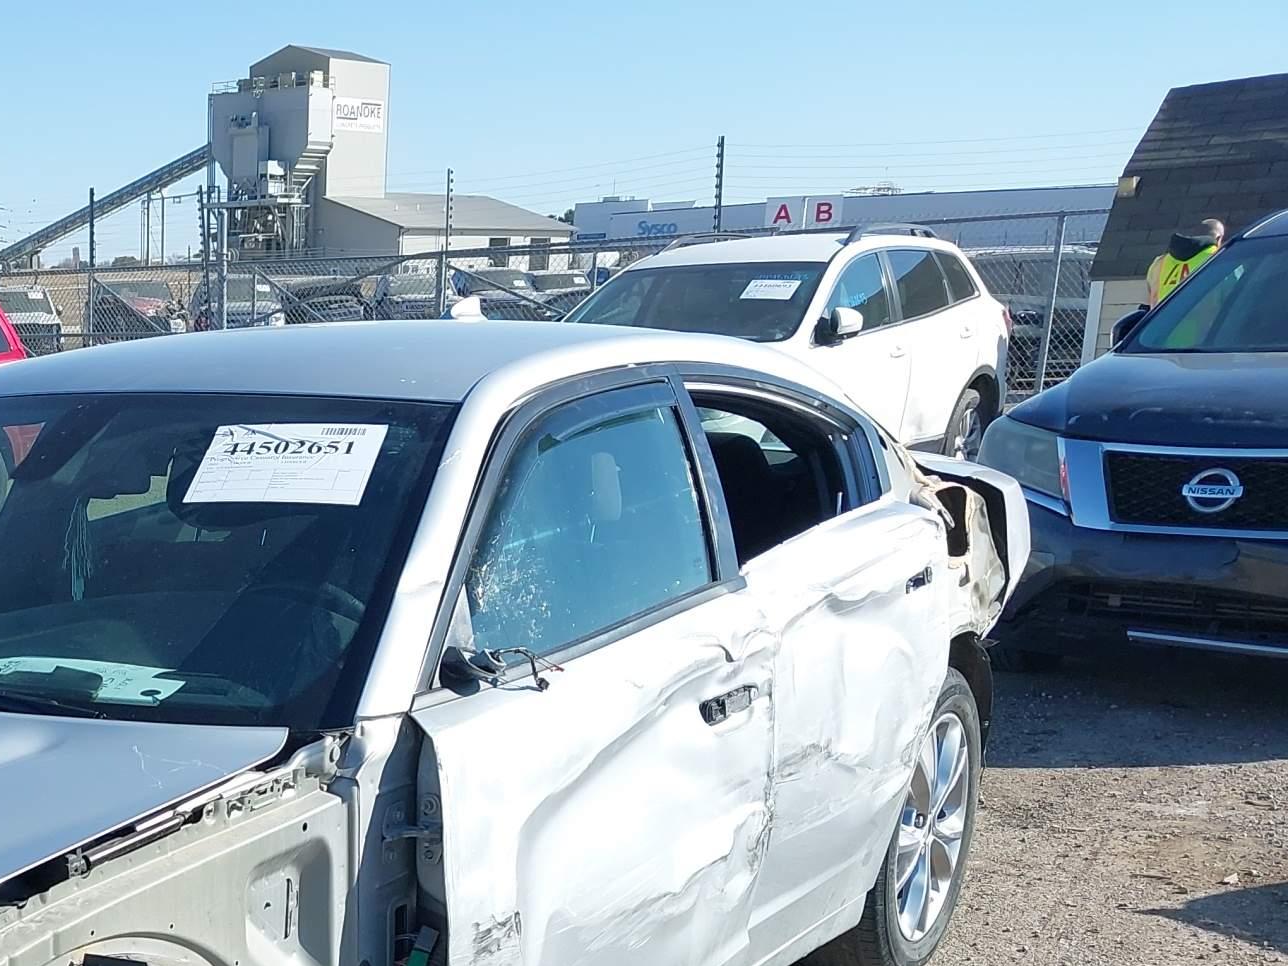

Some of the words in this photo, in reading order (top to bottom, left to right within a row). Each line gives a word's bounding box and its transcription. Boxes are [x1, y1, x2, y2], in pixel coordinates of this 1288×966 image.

[336, 103, 381, 119] ROANOKE
[773, 203, 792, 224] A
[815, 202, 833, 223] B
[638, 220, 678, 236] Sysco
[223, 440, 355, 456] 44502651
[1187, 487, 1236, 496] NISSAN
